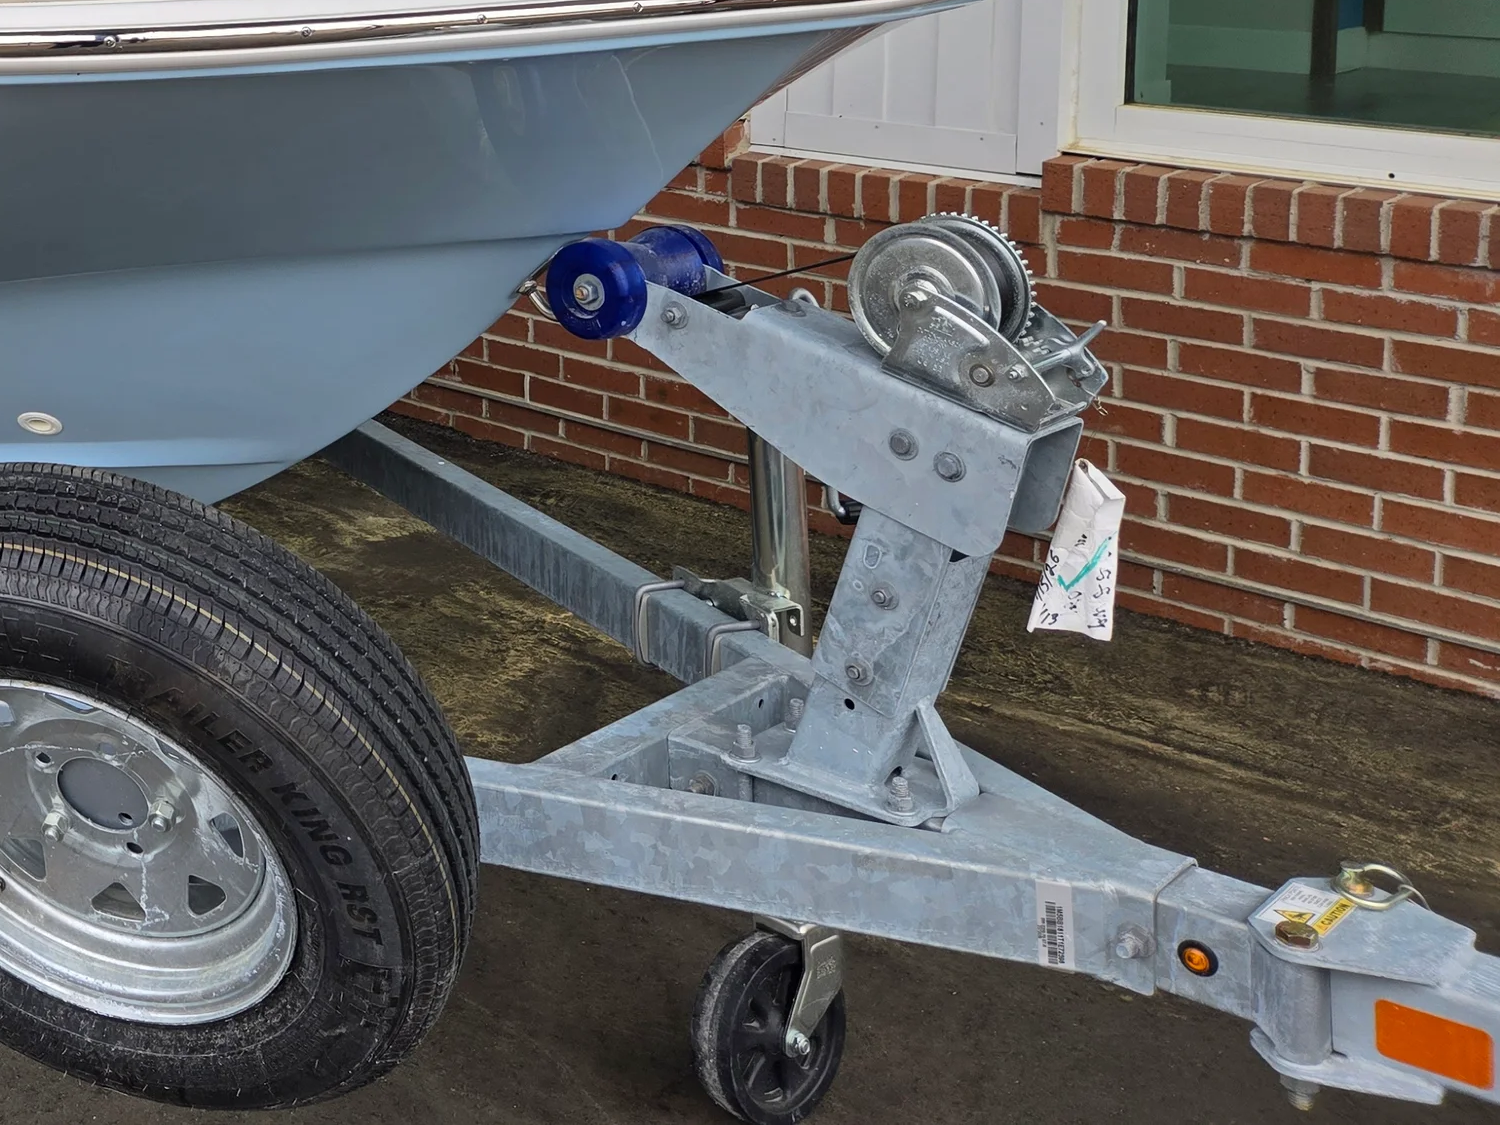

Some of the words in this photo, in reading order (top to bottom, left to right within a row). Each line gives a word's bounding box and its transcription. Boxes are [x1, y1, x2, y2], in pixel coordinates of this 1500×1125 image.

[271, 782, 353, 866] KING
[334, 881, 383, 945] RST
[1320, 902, 1351, 926] CAUTION
